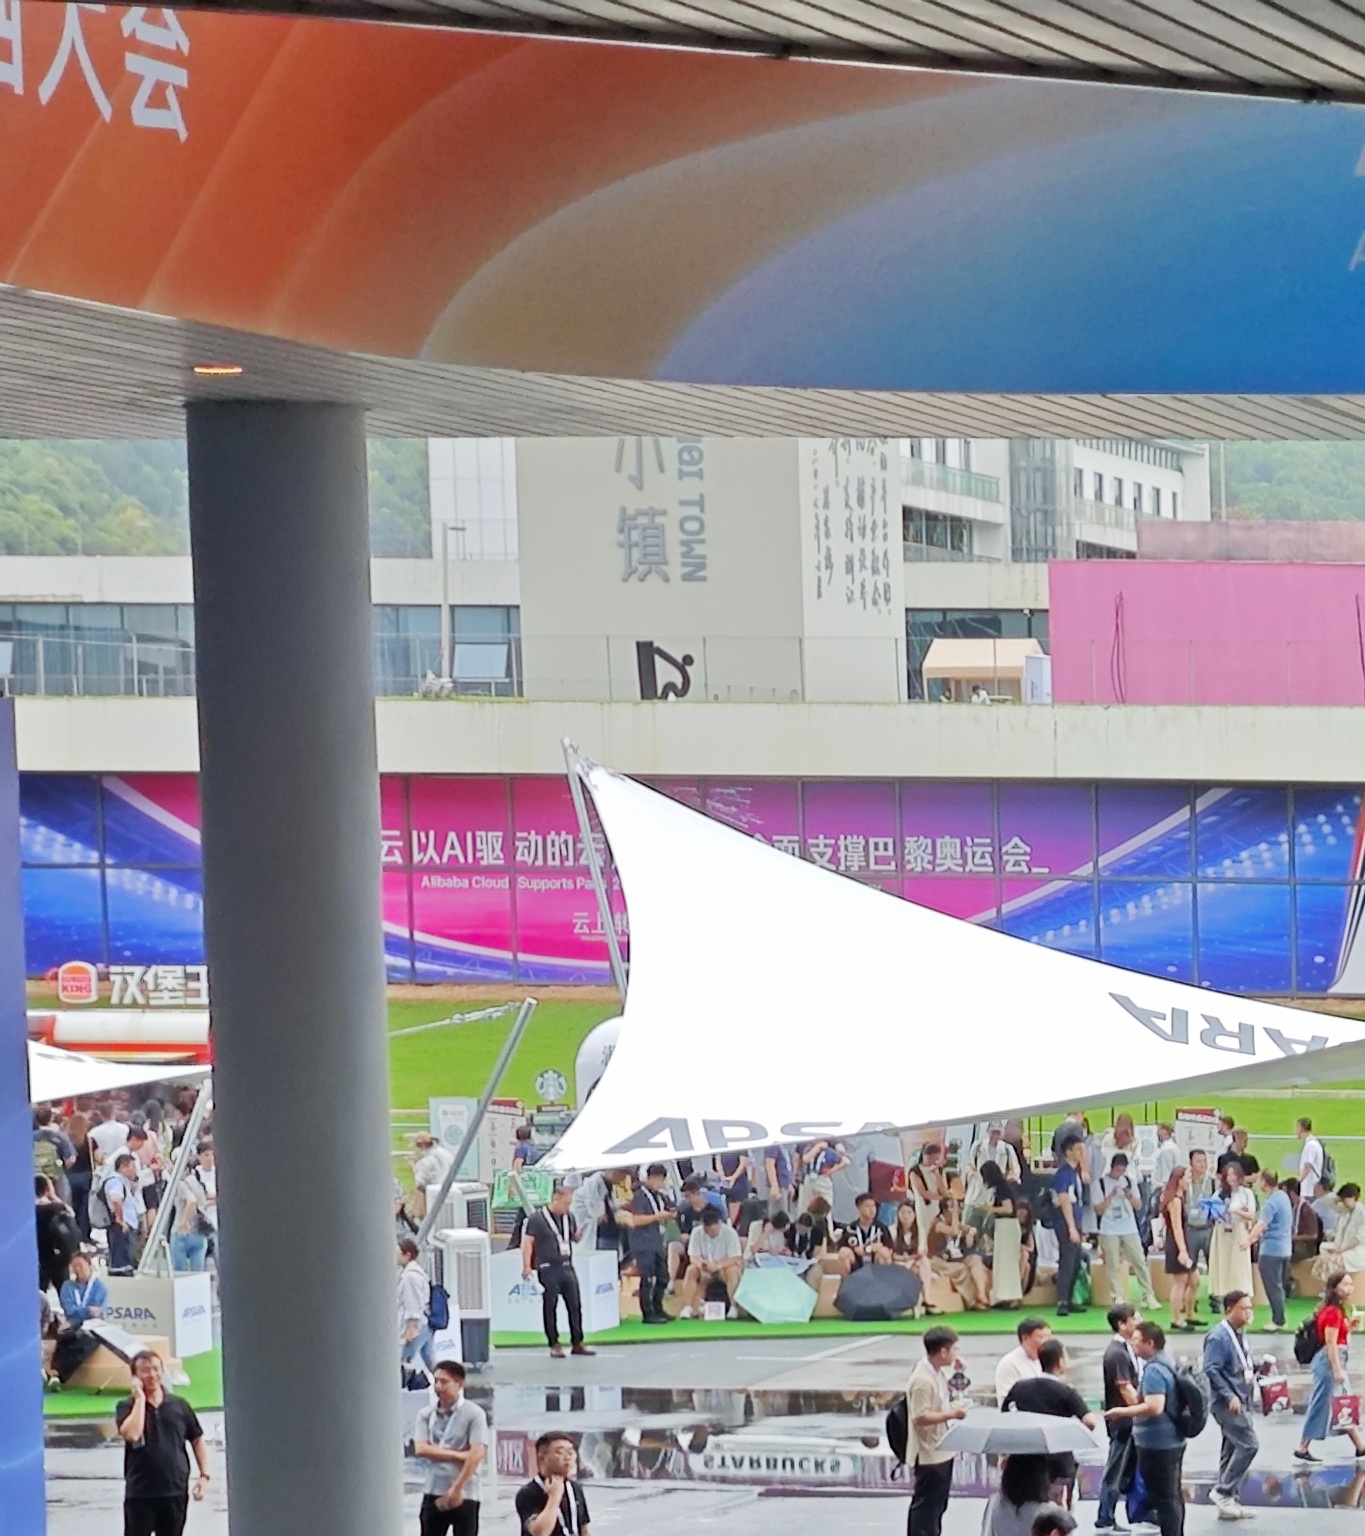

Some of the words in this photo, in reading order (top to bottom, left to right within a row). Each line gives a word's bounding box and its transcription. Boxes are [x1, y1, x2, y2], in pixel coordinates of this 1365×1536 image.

[614, 437, 670, 582] 小镇
[679, 493, 708, 582] TOWN
[421, 875, 468, 889] Alibaba
[472, 875, 509, 889] Cloud
[517, 876, 574, 892] Supports
[102, 1306, 156, 1320] PSARA
